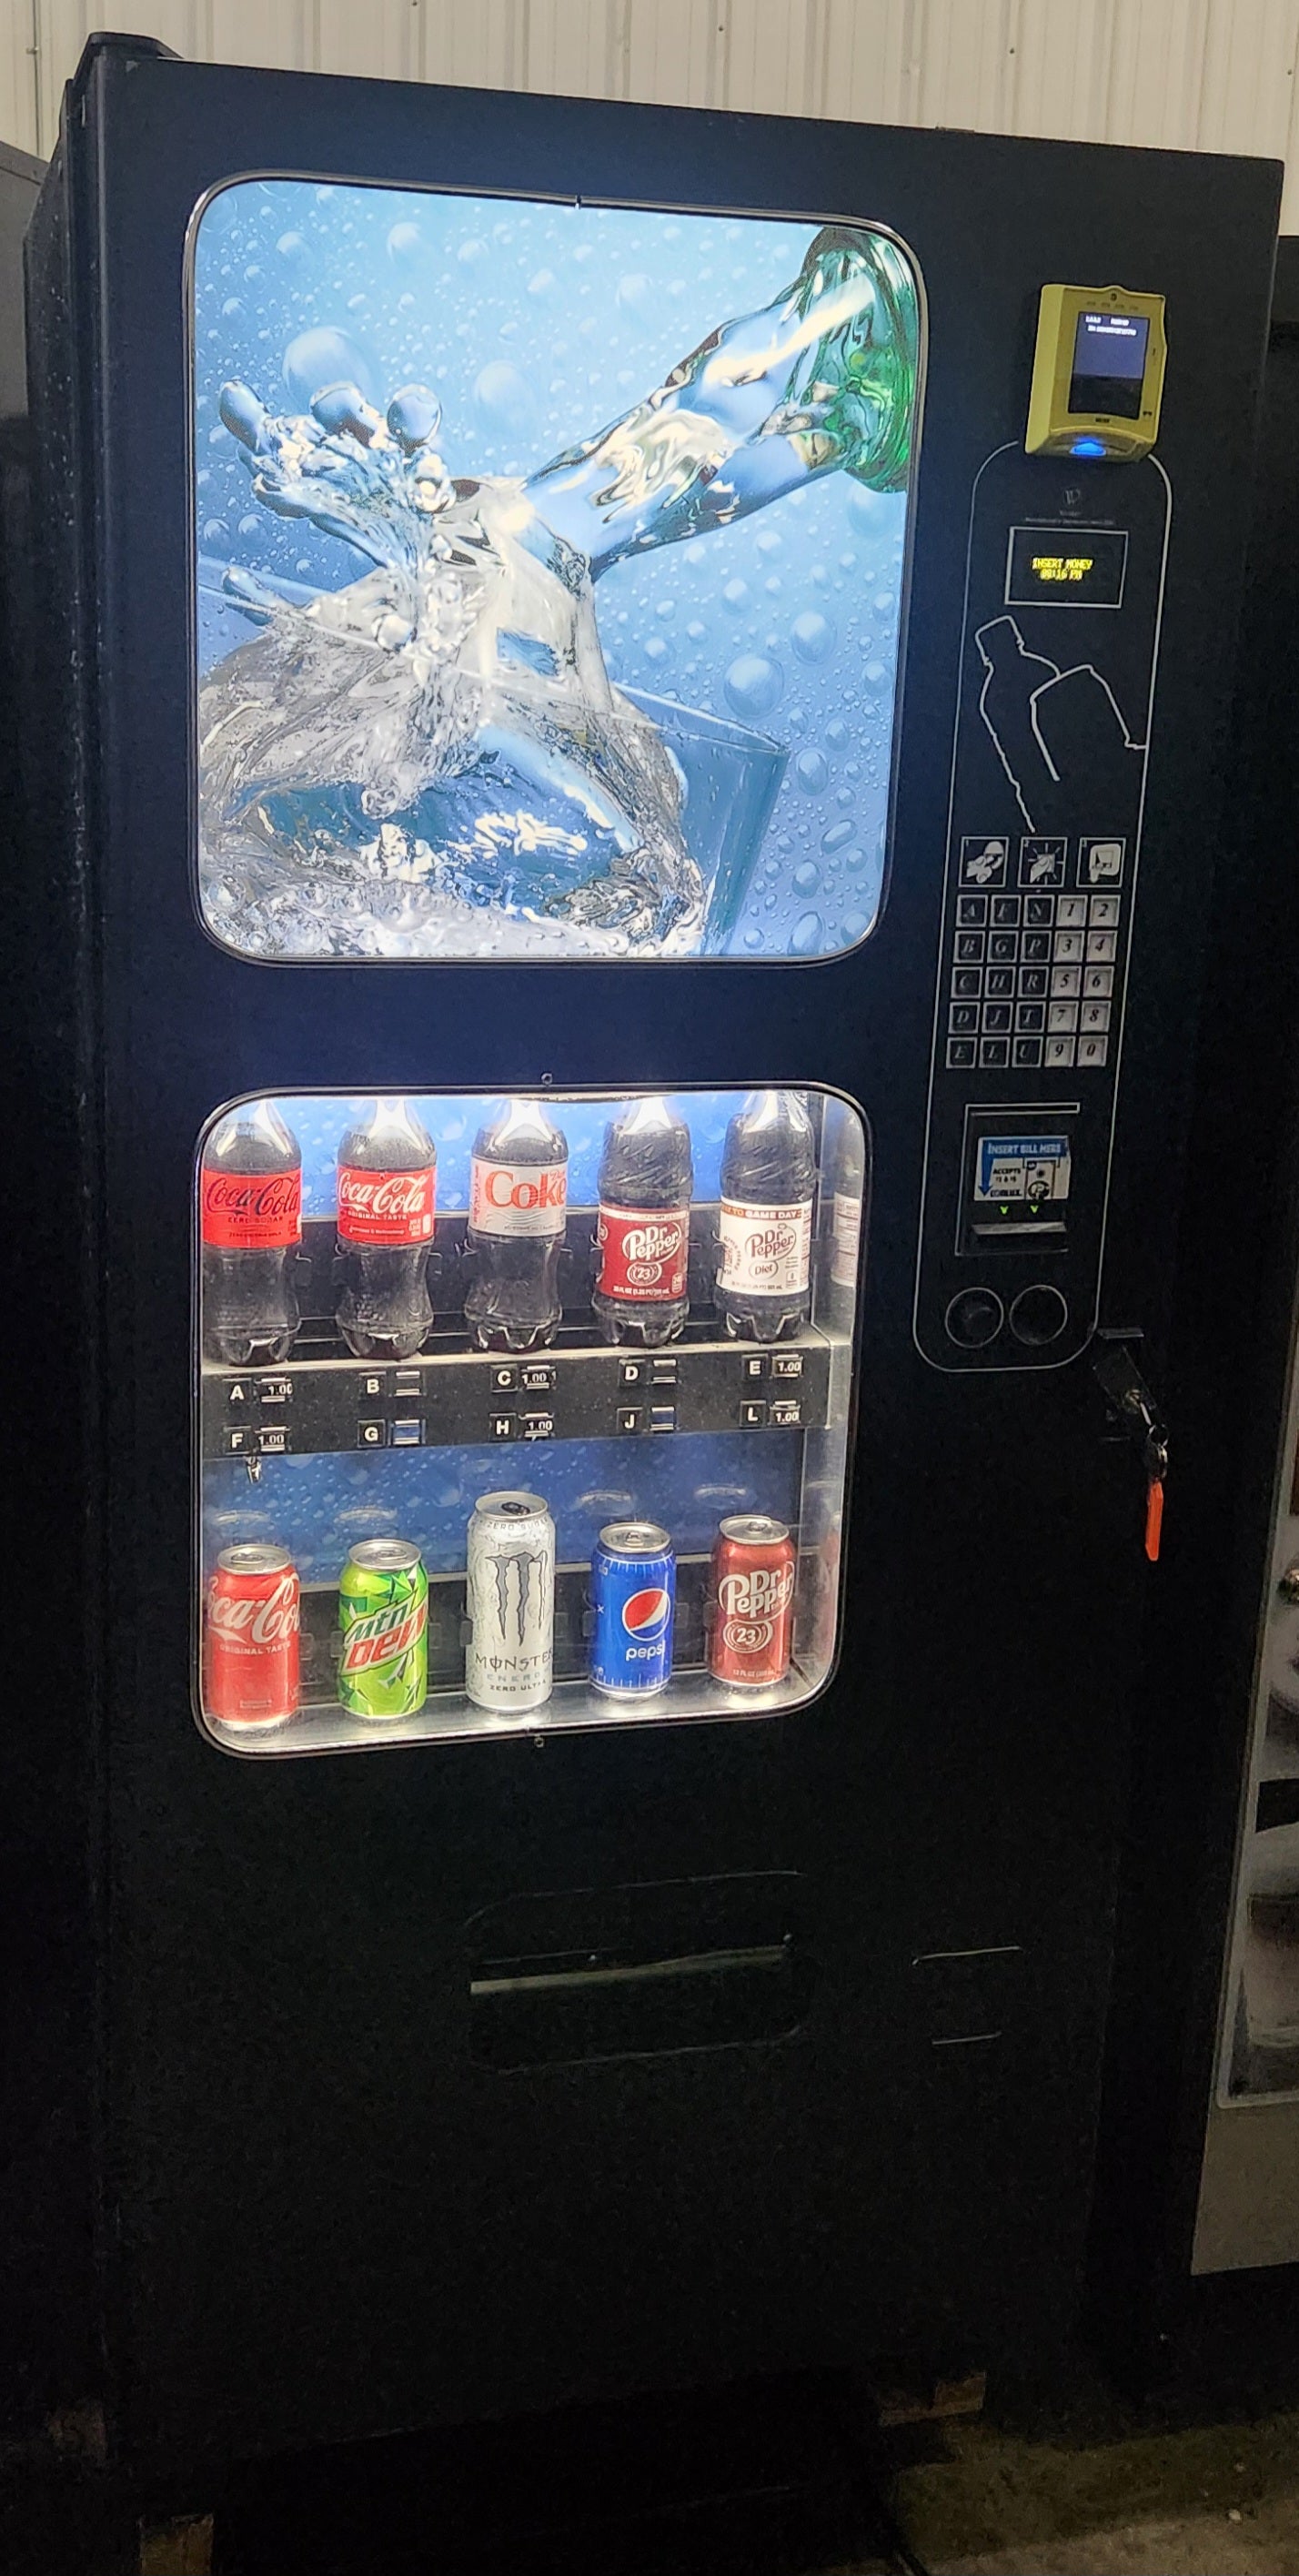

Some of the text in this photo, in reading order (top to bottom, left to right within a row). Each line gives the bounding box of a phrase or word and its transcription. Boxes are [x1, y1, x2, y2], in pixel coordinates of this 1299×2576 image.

[1032, 557, 1093, 571] INSERT MONEY
[962, 904, 975, 917] A
[1067, 903, 1074, 916] 1
[1098, 903, 1109, 917] 2
[961, 939, 975, 954] B
[995, 938, 1009, 954] G
[1028, 939, 1042, 954] P
[1062, 938, 1072, 953] 3
[1095, 938, 1105, 952] 4
[959, 975, 972, 989] C
[991, 975, 1007, 989] H
[1026, 974, 1039, 989] R
[1060, 974, 1070, 988] 5
[1093, 974, 1102, 988] 6
[956, 1010, 970, 1024] D
[989, 1009, 1002, 1025] J
[1056, 1009, 1066, 1022] 7
[1089, 1008, 1100, 1022] 8
[954, 1046, 967, 1059] E
[1054, 1043, 1064, 1057] 9
[1086, 1043, 1096, 1057] 0
[988, 1143, 1061, 1155] INSERT BILL HERE
[206, 1174, 300, 1217] Coca-Cola
[338, 1171, 429, 1215] Coca-Cola
[484, 1170, 567, 1209] Coke
[732, 1207, 797, 1219] TO GAME DAY
[645, 1225, 668, 1245] Dr
[764, 1228, 783, 1244] Dr
[622, 1228, 679, 1261] Pepper
[745, 1233, 794, 1258] Pepper
[637, 1268, 651, 1280] 23
[754, 1264, 773, 1275] Diet
[625, 1367, 639, 1380] D
[750, 1360, 760, 1375] E
[779, 1361, 801, 1372] 1.00
[497, 1370, 511, 1386] C
[521, 1372, 548, 1384] 1.00
[229, 1385, 245, 1400] A
[268, 1382, 293, 1396] 1.00
[368, 1379, 379, 1394] B
[748, 1407, 759, 1421] L
[776, 1411, 800, 1422] 1.00
[496, 1420, 509, 1435] H
[528, 1420, 553, 1431] 1.00
[624, 1415, 635, 1429] J
[258, 1434, 285, 1446] 1.00
[365, 1426, 378, 1441] G
[231, 1433, 243, 1449] F
[750, 1569, 781, 1597] Dr
[719, 1571, 793, 1619] Pepper
[736, 1627, 756, 1645] 23
